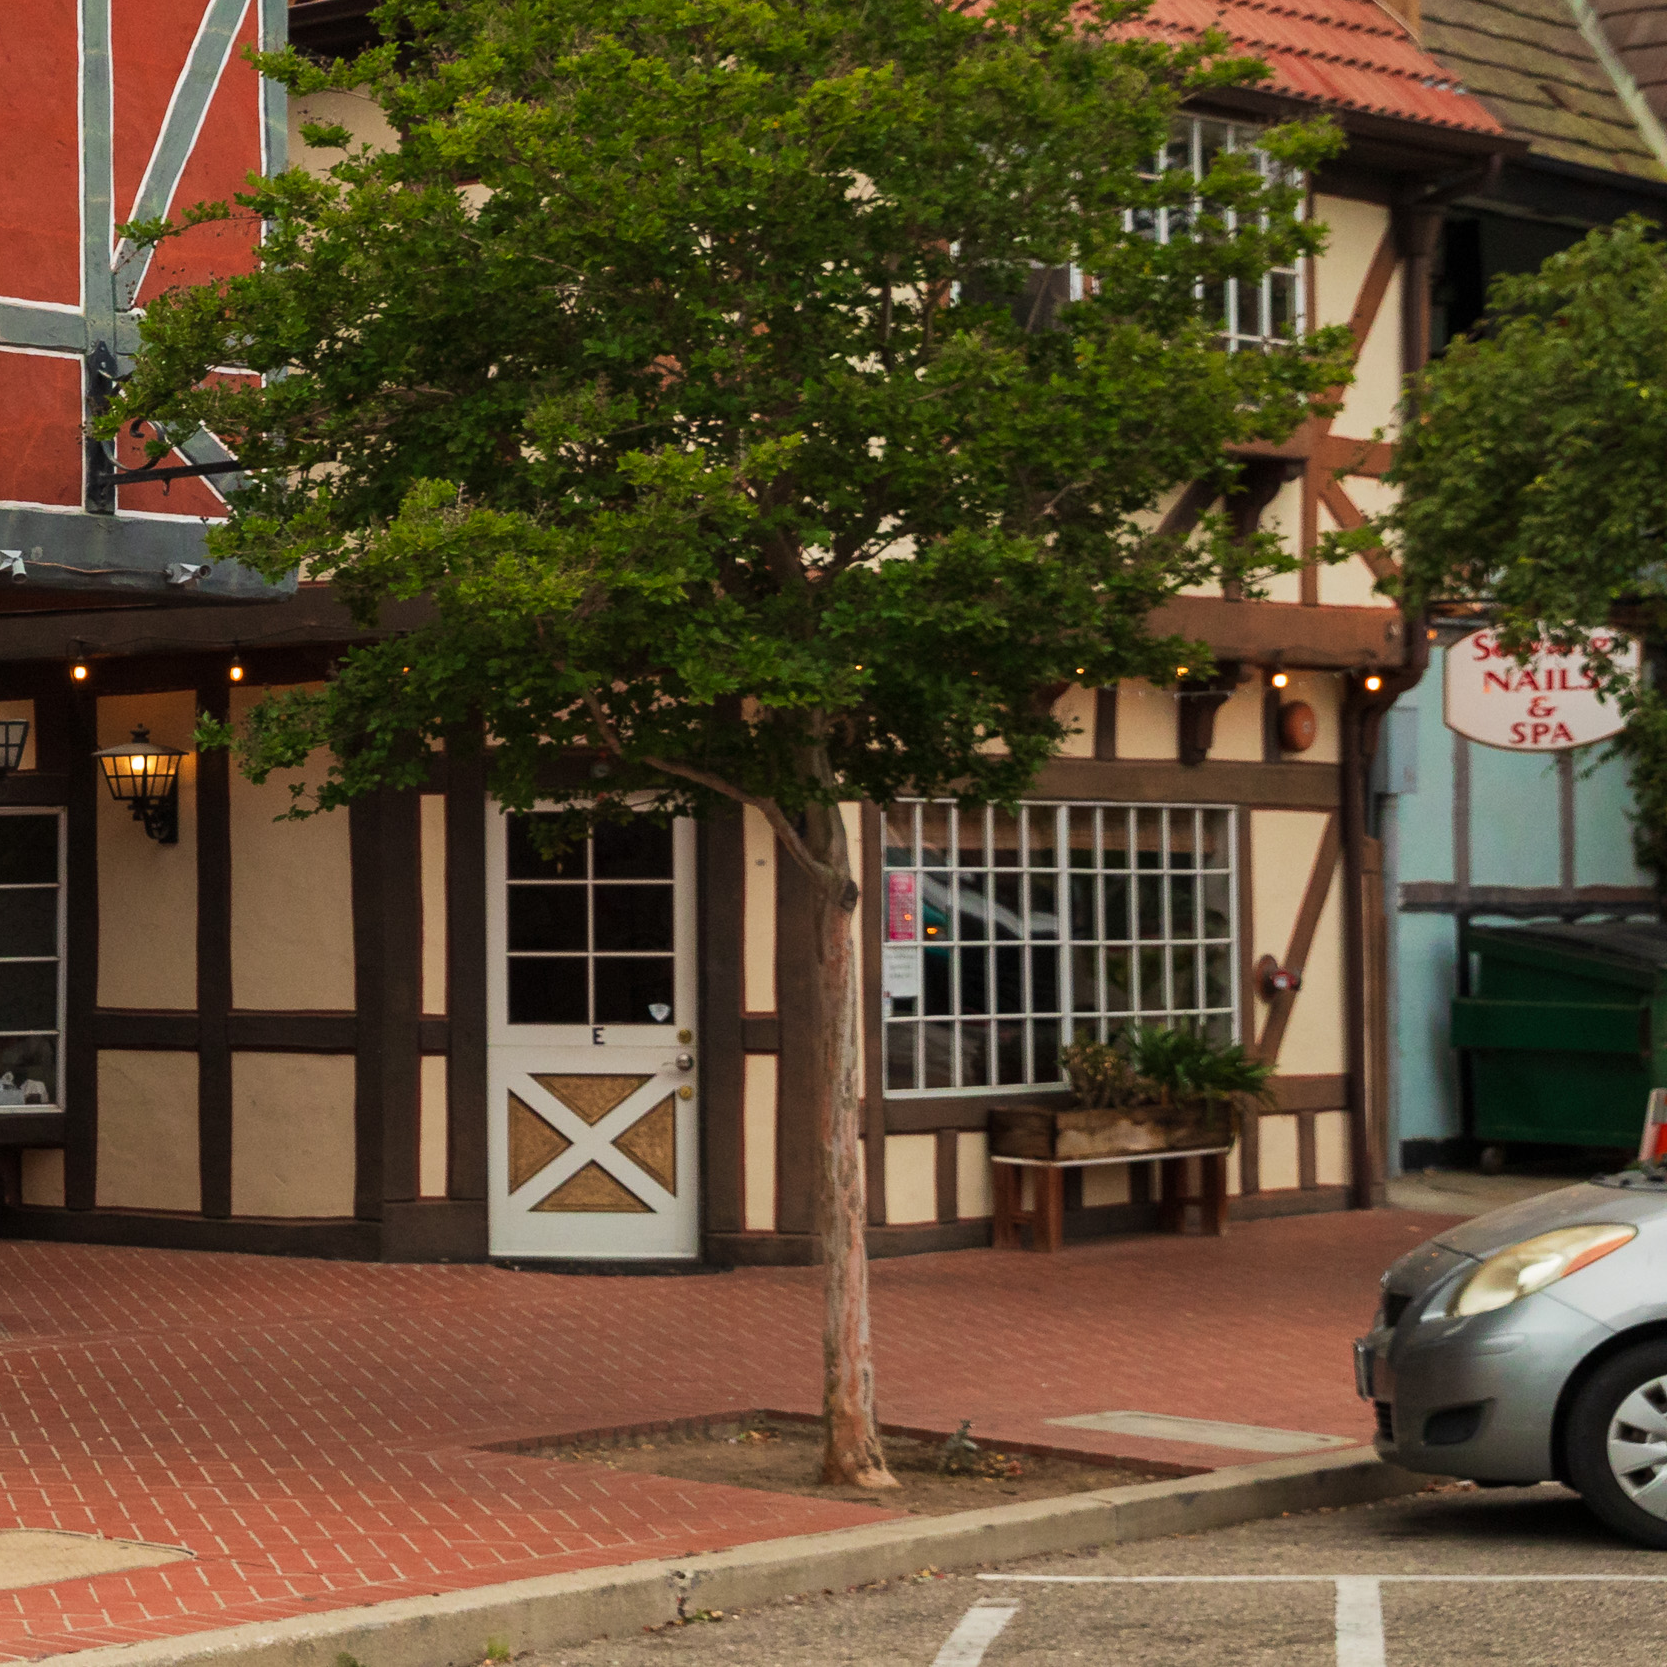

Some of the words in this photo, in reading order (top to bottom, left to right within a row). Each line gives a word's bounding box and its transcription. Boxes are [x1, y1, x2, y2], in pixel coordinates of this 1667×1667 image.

[1483, 669, 1600, 692] NAILS
[1527, 696, 1556, 718] &
[1509, 722, 1574, 744] SPA
